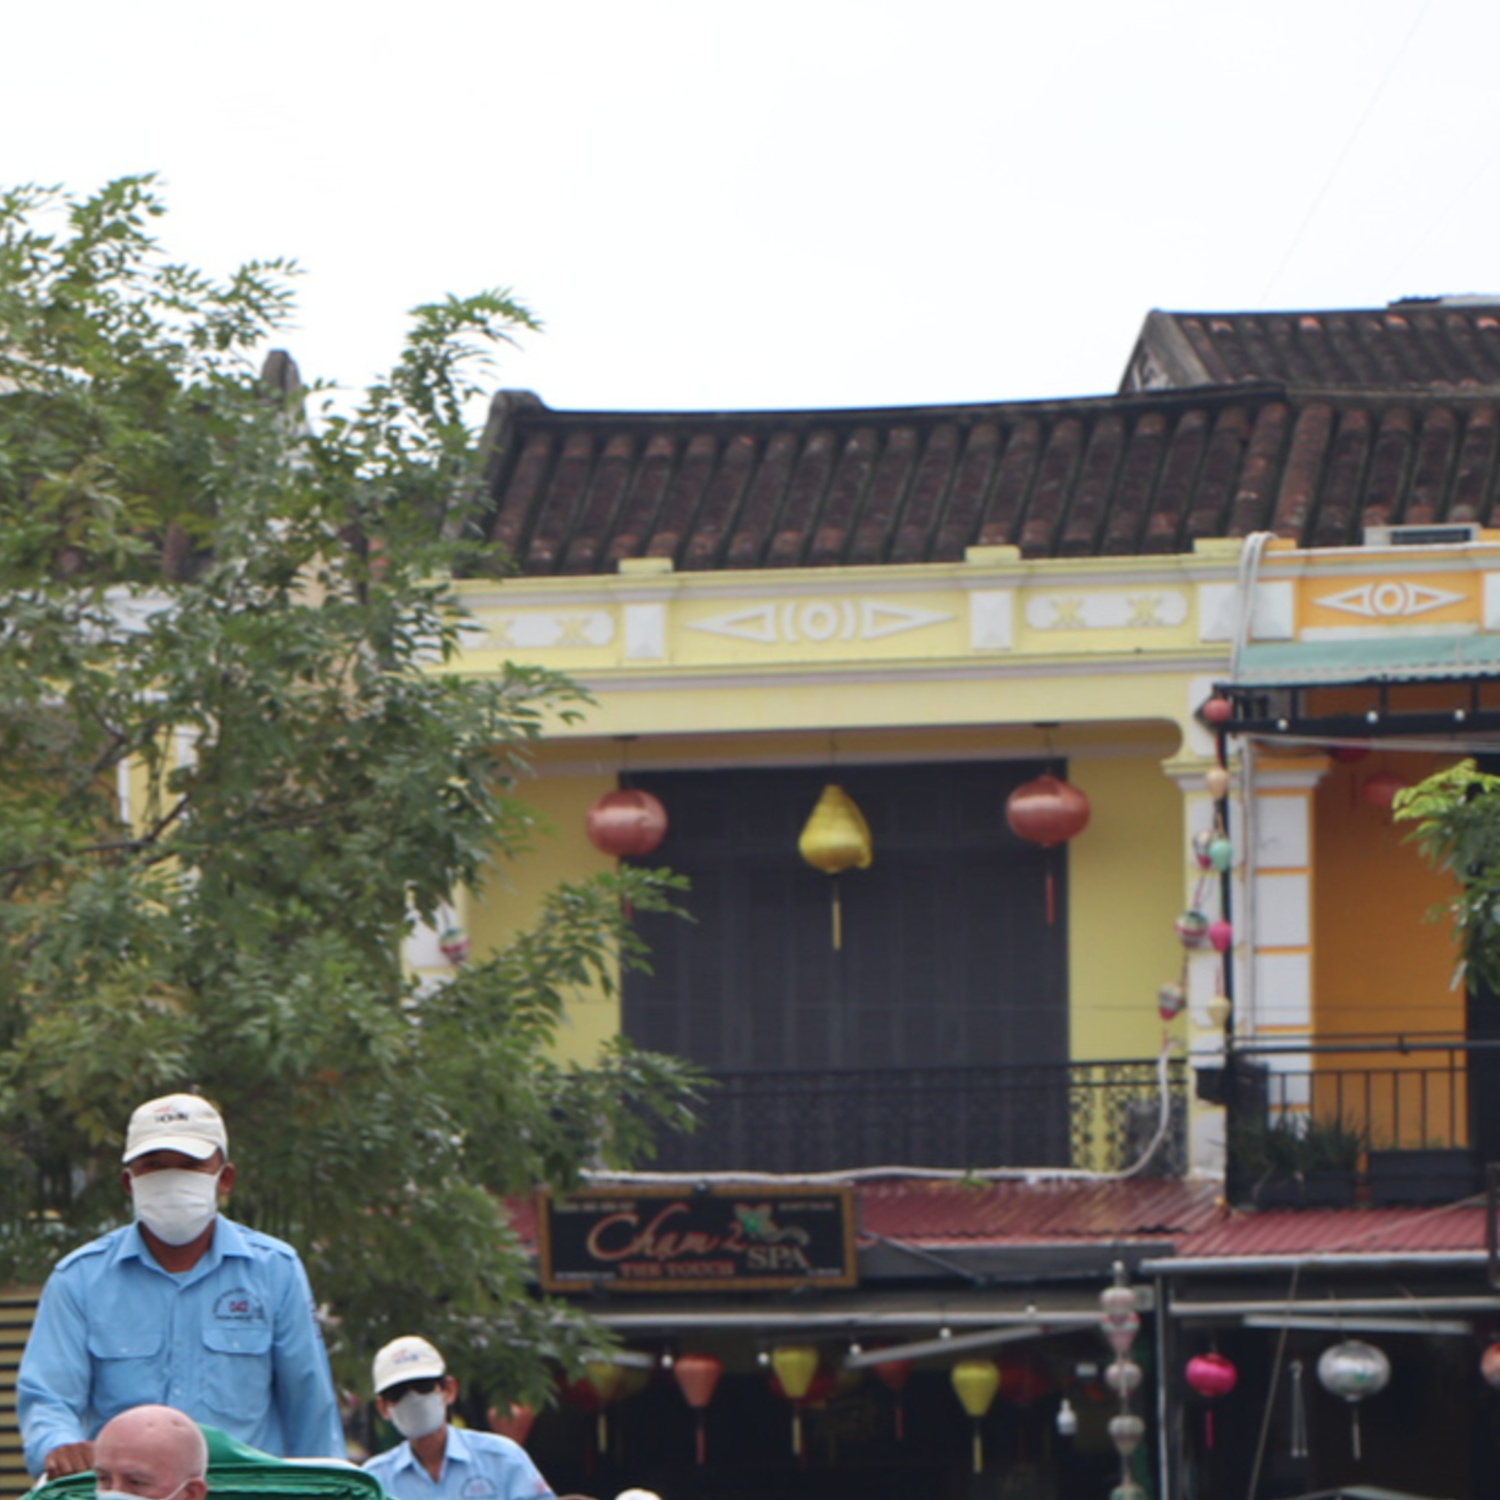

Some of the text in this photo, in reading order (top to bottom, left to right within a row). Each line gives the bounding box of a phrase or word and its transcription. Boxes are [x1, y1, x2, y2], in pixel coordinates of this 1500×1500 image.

[747, 1246, 812, 1269] SPA
[619, 1261, 663, 1278] THE
[665, 1260, 736, 1277] TOUCH
